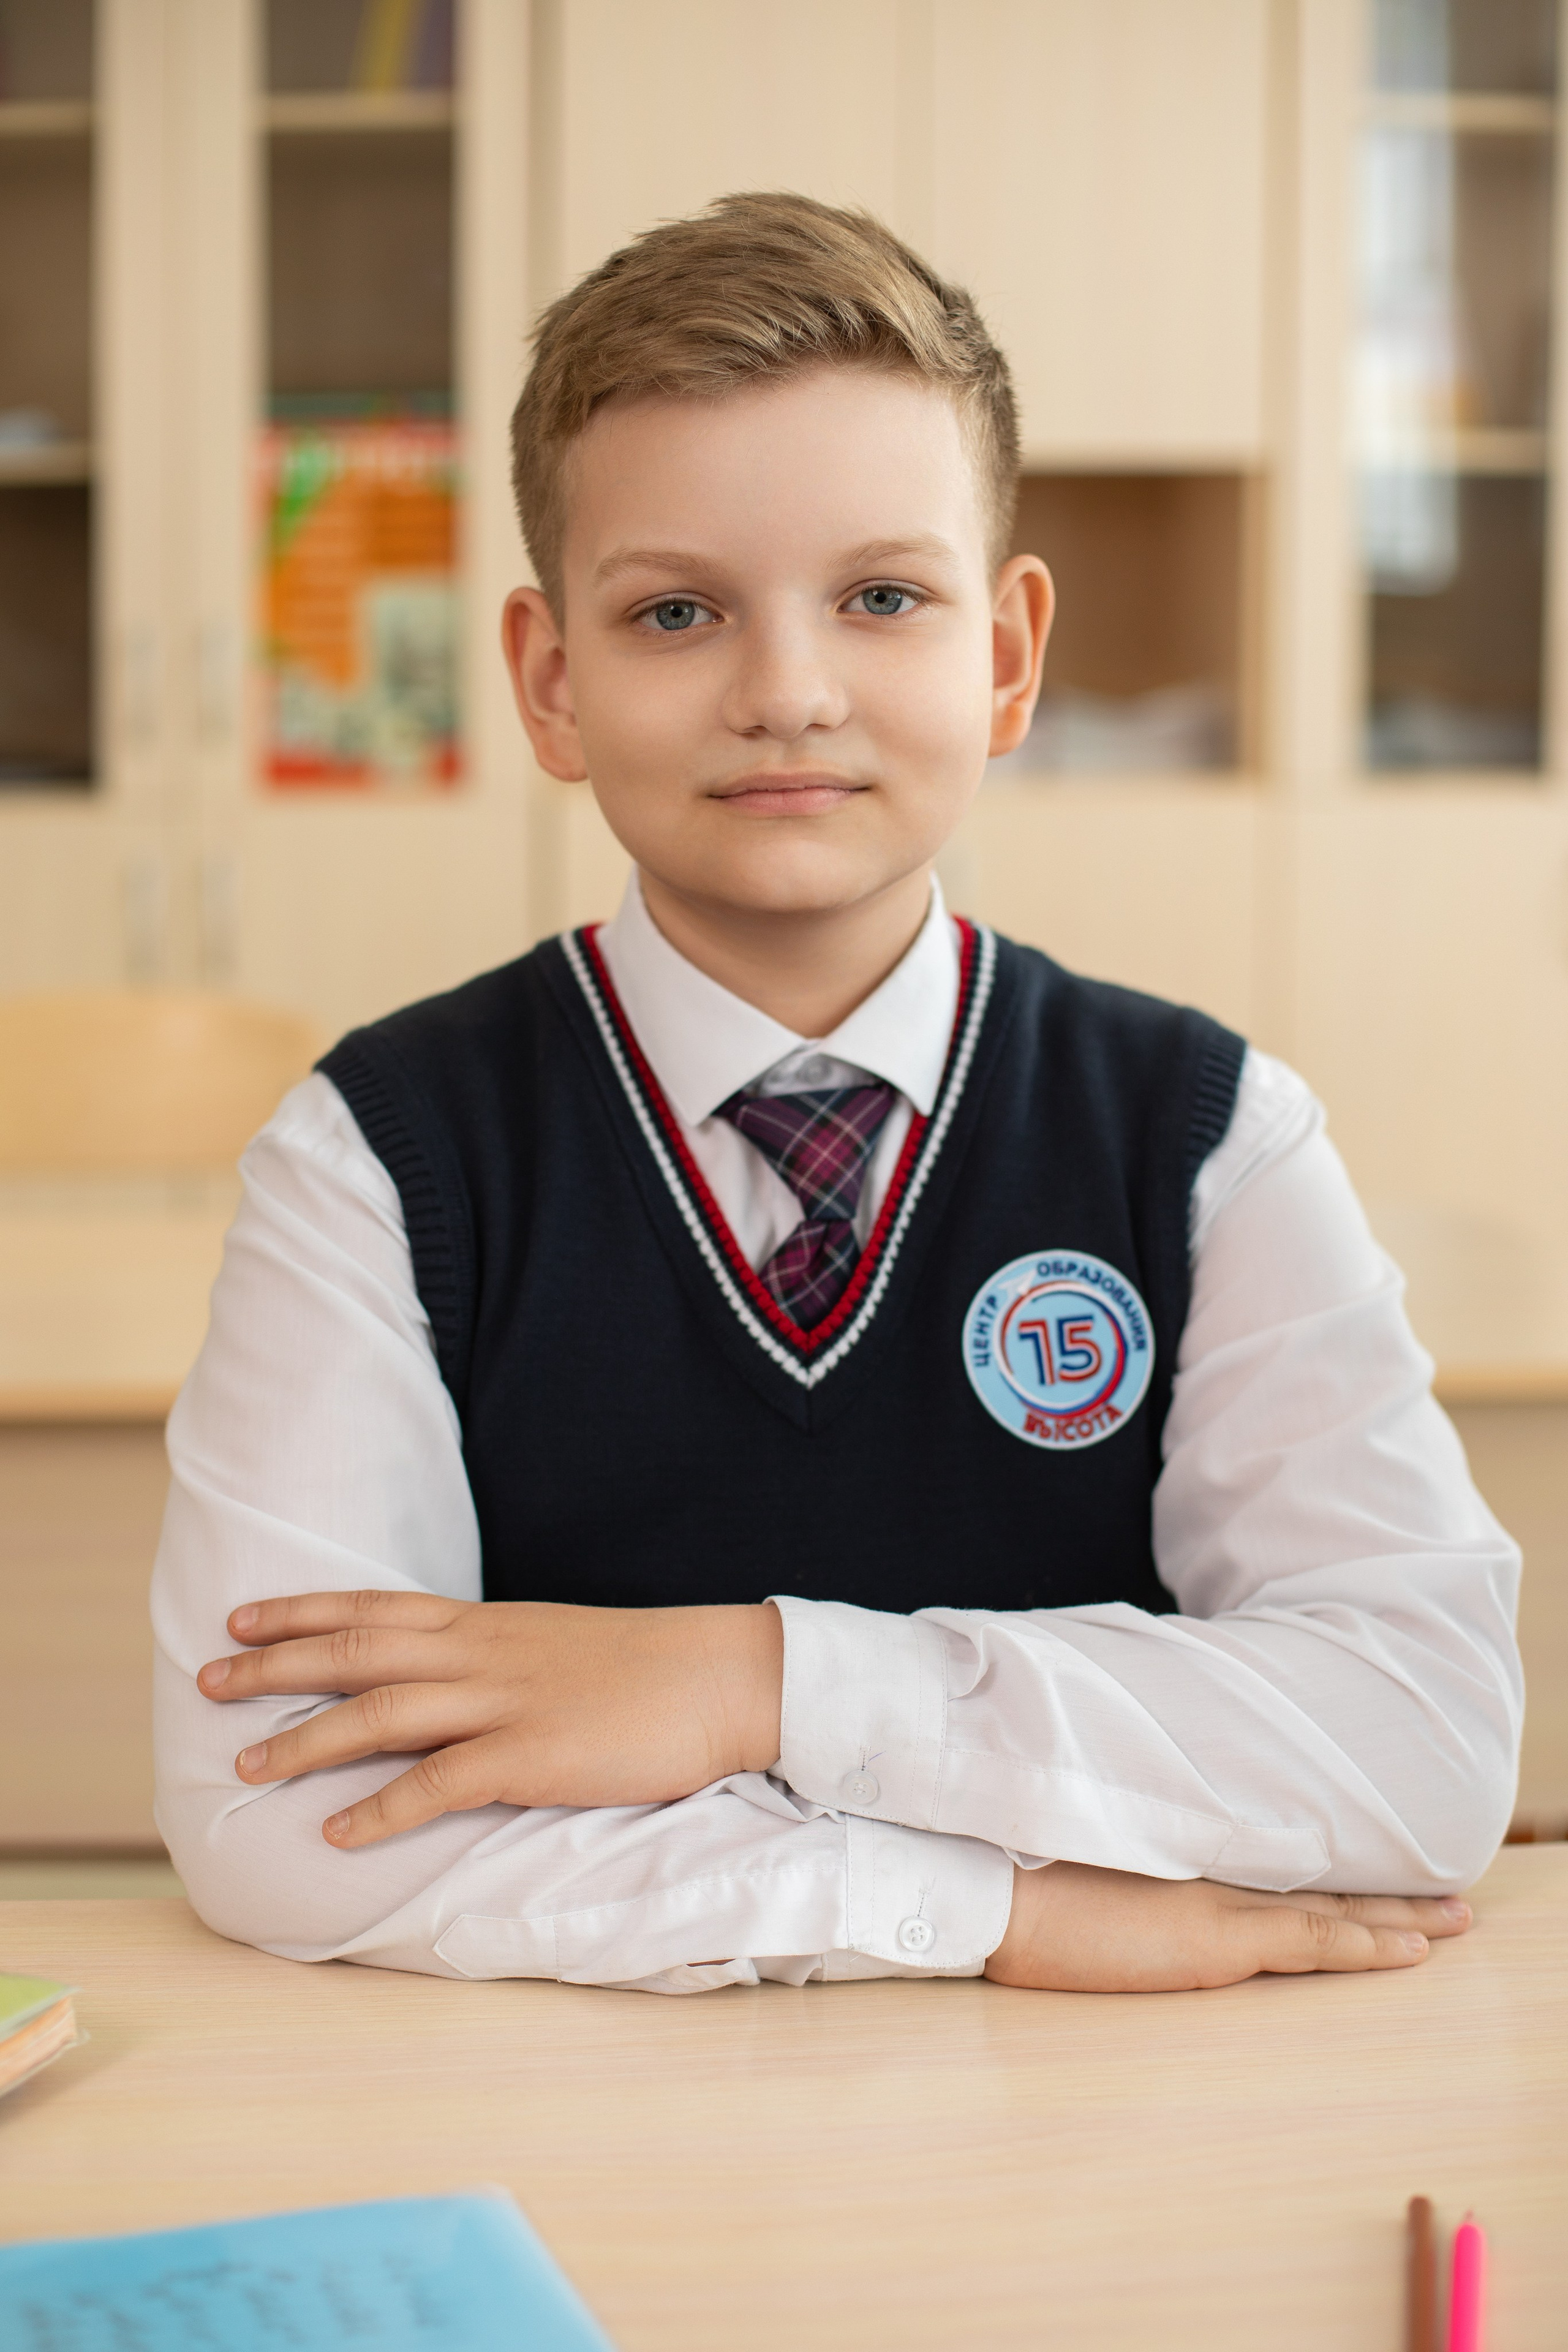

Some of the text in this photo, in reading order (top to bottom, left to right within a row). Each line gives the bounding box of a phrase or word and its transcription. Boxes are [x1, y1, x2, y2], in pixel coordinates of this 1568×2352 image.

[973, 1260, 1147, 1368] ЦЕНТР ОБРАЗОВАНИЯ
[1018, 1315, 1101, 1385] 15
[1023, 1404, 1123, 1441] ВЫСОТА
